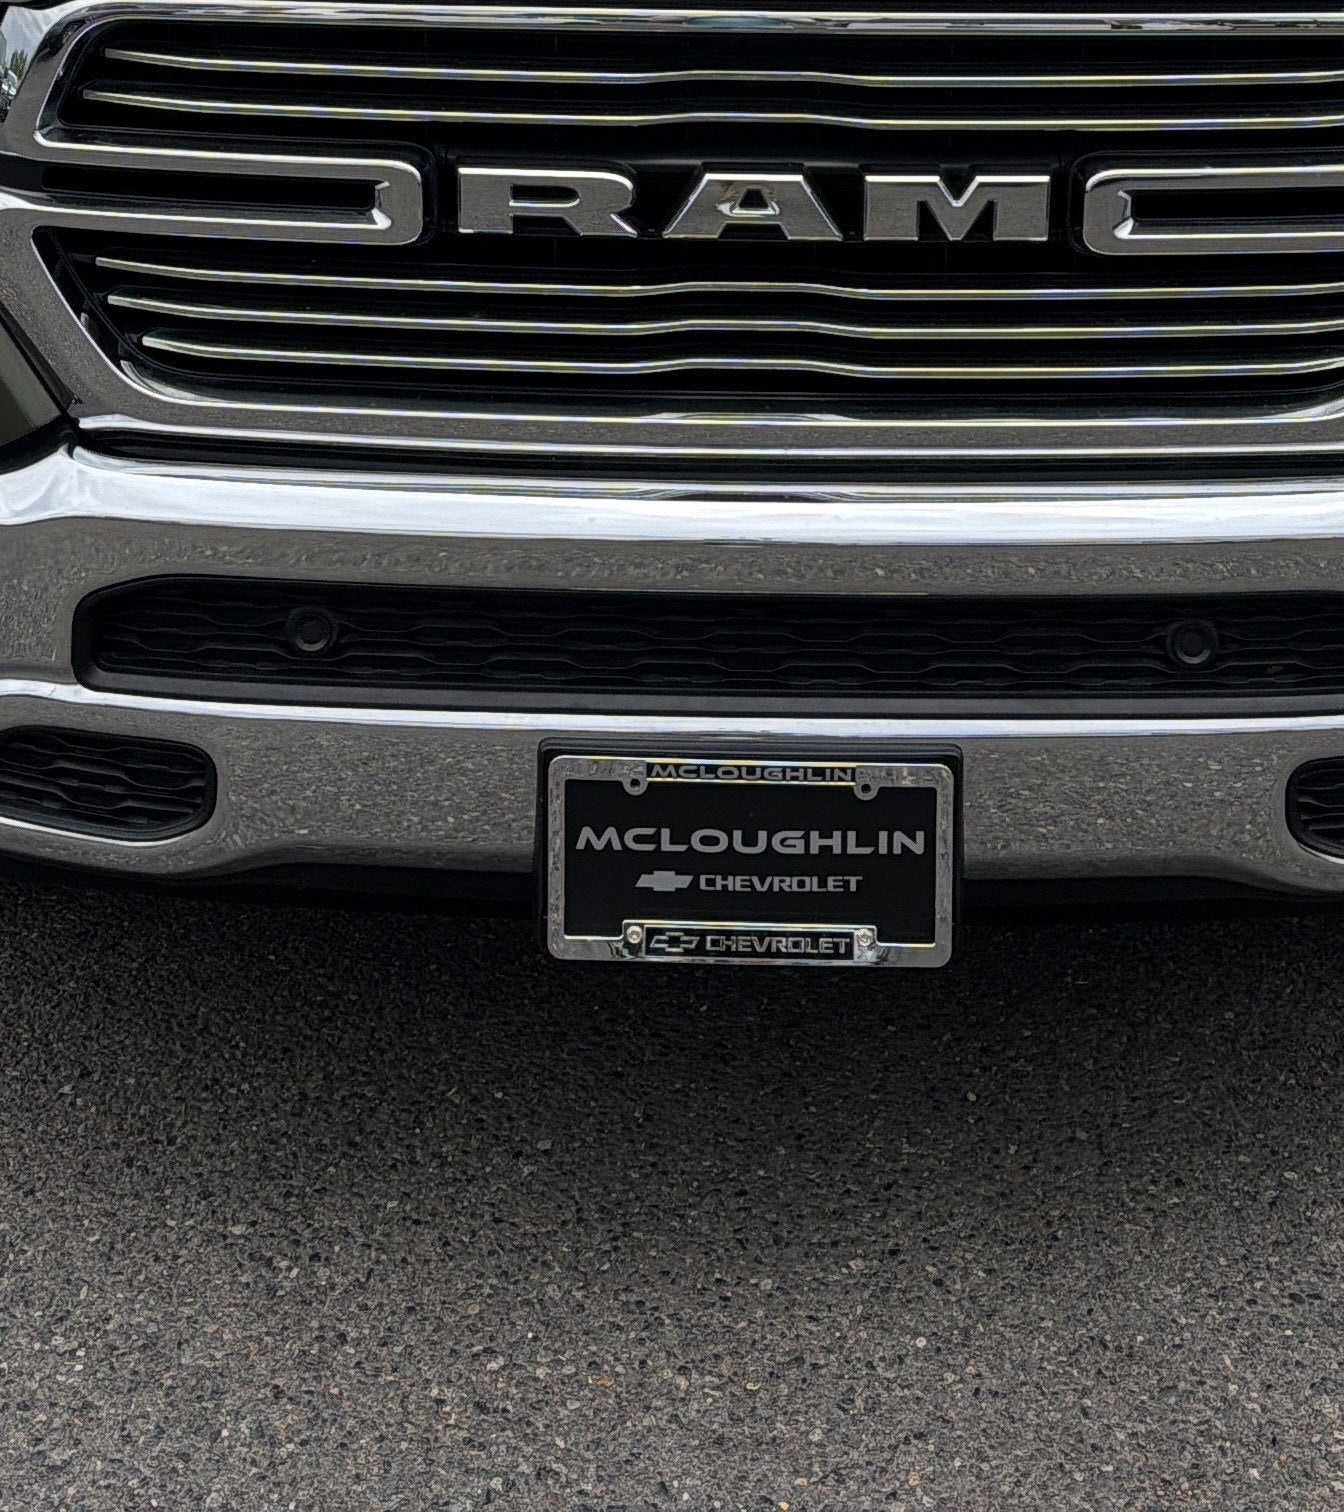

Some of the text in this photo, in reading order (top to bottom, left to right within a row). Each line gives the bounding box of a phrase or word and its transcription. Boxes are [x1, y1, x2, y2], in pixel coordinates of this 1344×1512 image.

[458, 167, 1050, 241] RAM
[651, 764, 854, 782] MCLOUGHLIN
[575, 826, 925, 855] MCLOUGHLIN
[699, 875, 863, 892] CHEVROLET
[705, 935, 851, 954] CHEVROLET
